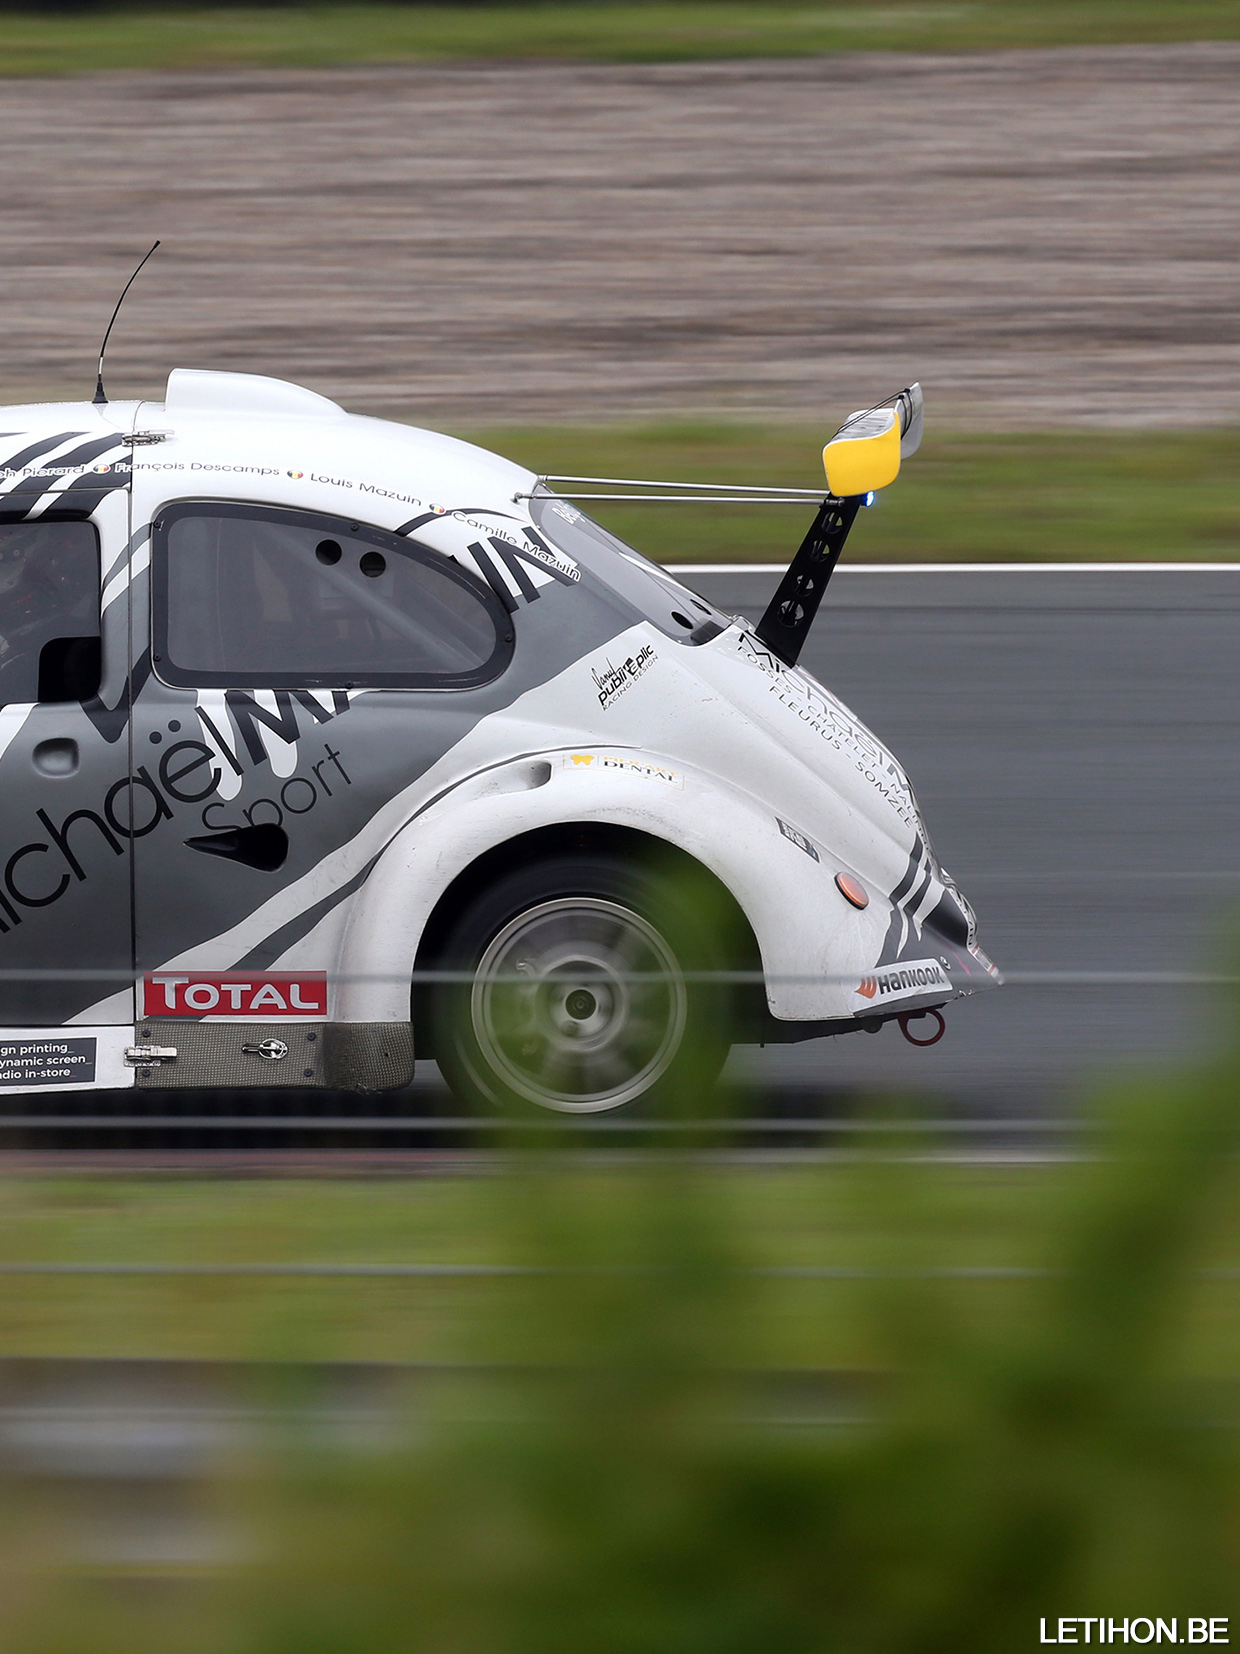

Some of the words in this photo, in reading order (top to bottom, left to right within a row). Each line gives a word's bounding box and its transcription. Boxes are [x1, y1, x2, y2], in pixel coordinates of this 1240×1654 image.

[22, 464, 85, 478] Pierard
[115, 462, 185, 475] François
[190, 461, 280, 477] Descamps
[310, 472, 353, 490] Louis
[359, 483, 422, 508] Mazuin
[453, 510, 519, 547] Camille
[522, 540, 581, 583] Mazuin
[603, 681, 633, 711] RACING
[633, 655, 658, 681] DESIGN
[738, 646, 793, 694] FOSSES
[808, 705, 880, 769] CHATELET
[202, 743, 352, 831] Sport
[604, 761, 678, 783] DENTAL
[769, 685, 842, 750] FLEURUS
[855, 761, 913, 829] SOMZEE
[152, 976, 322, 1011] TOTAL
